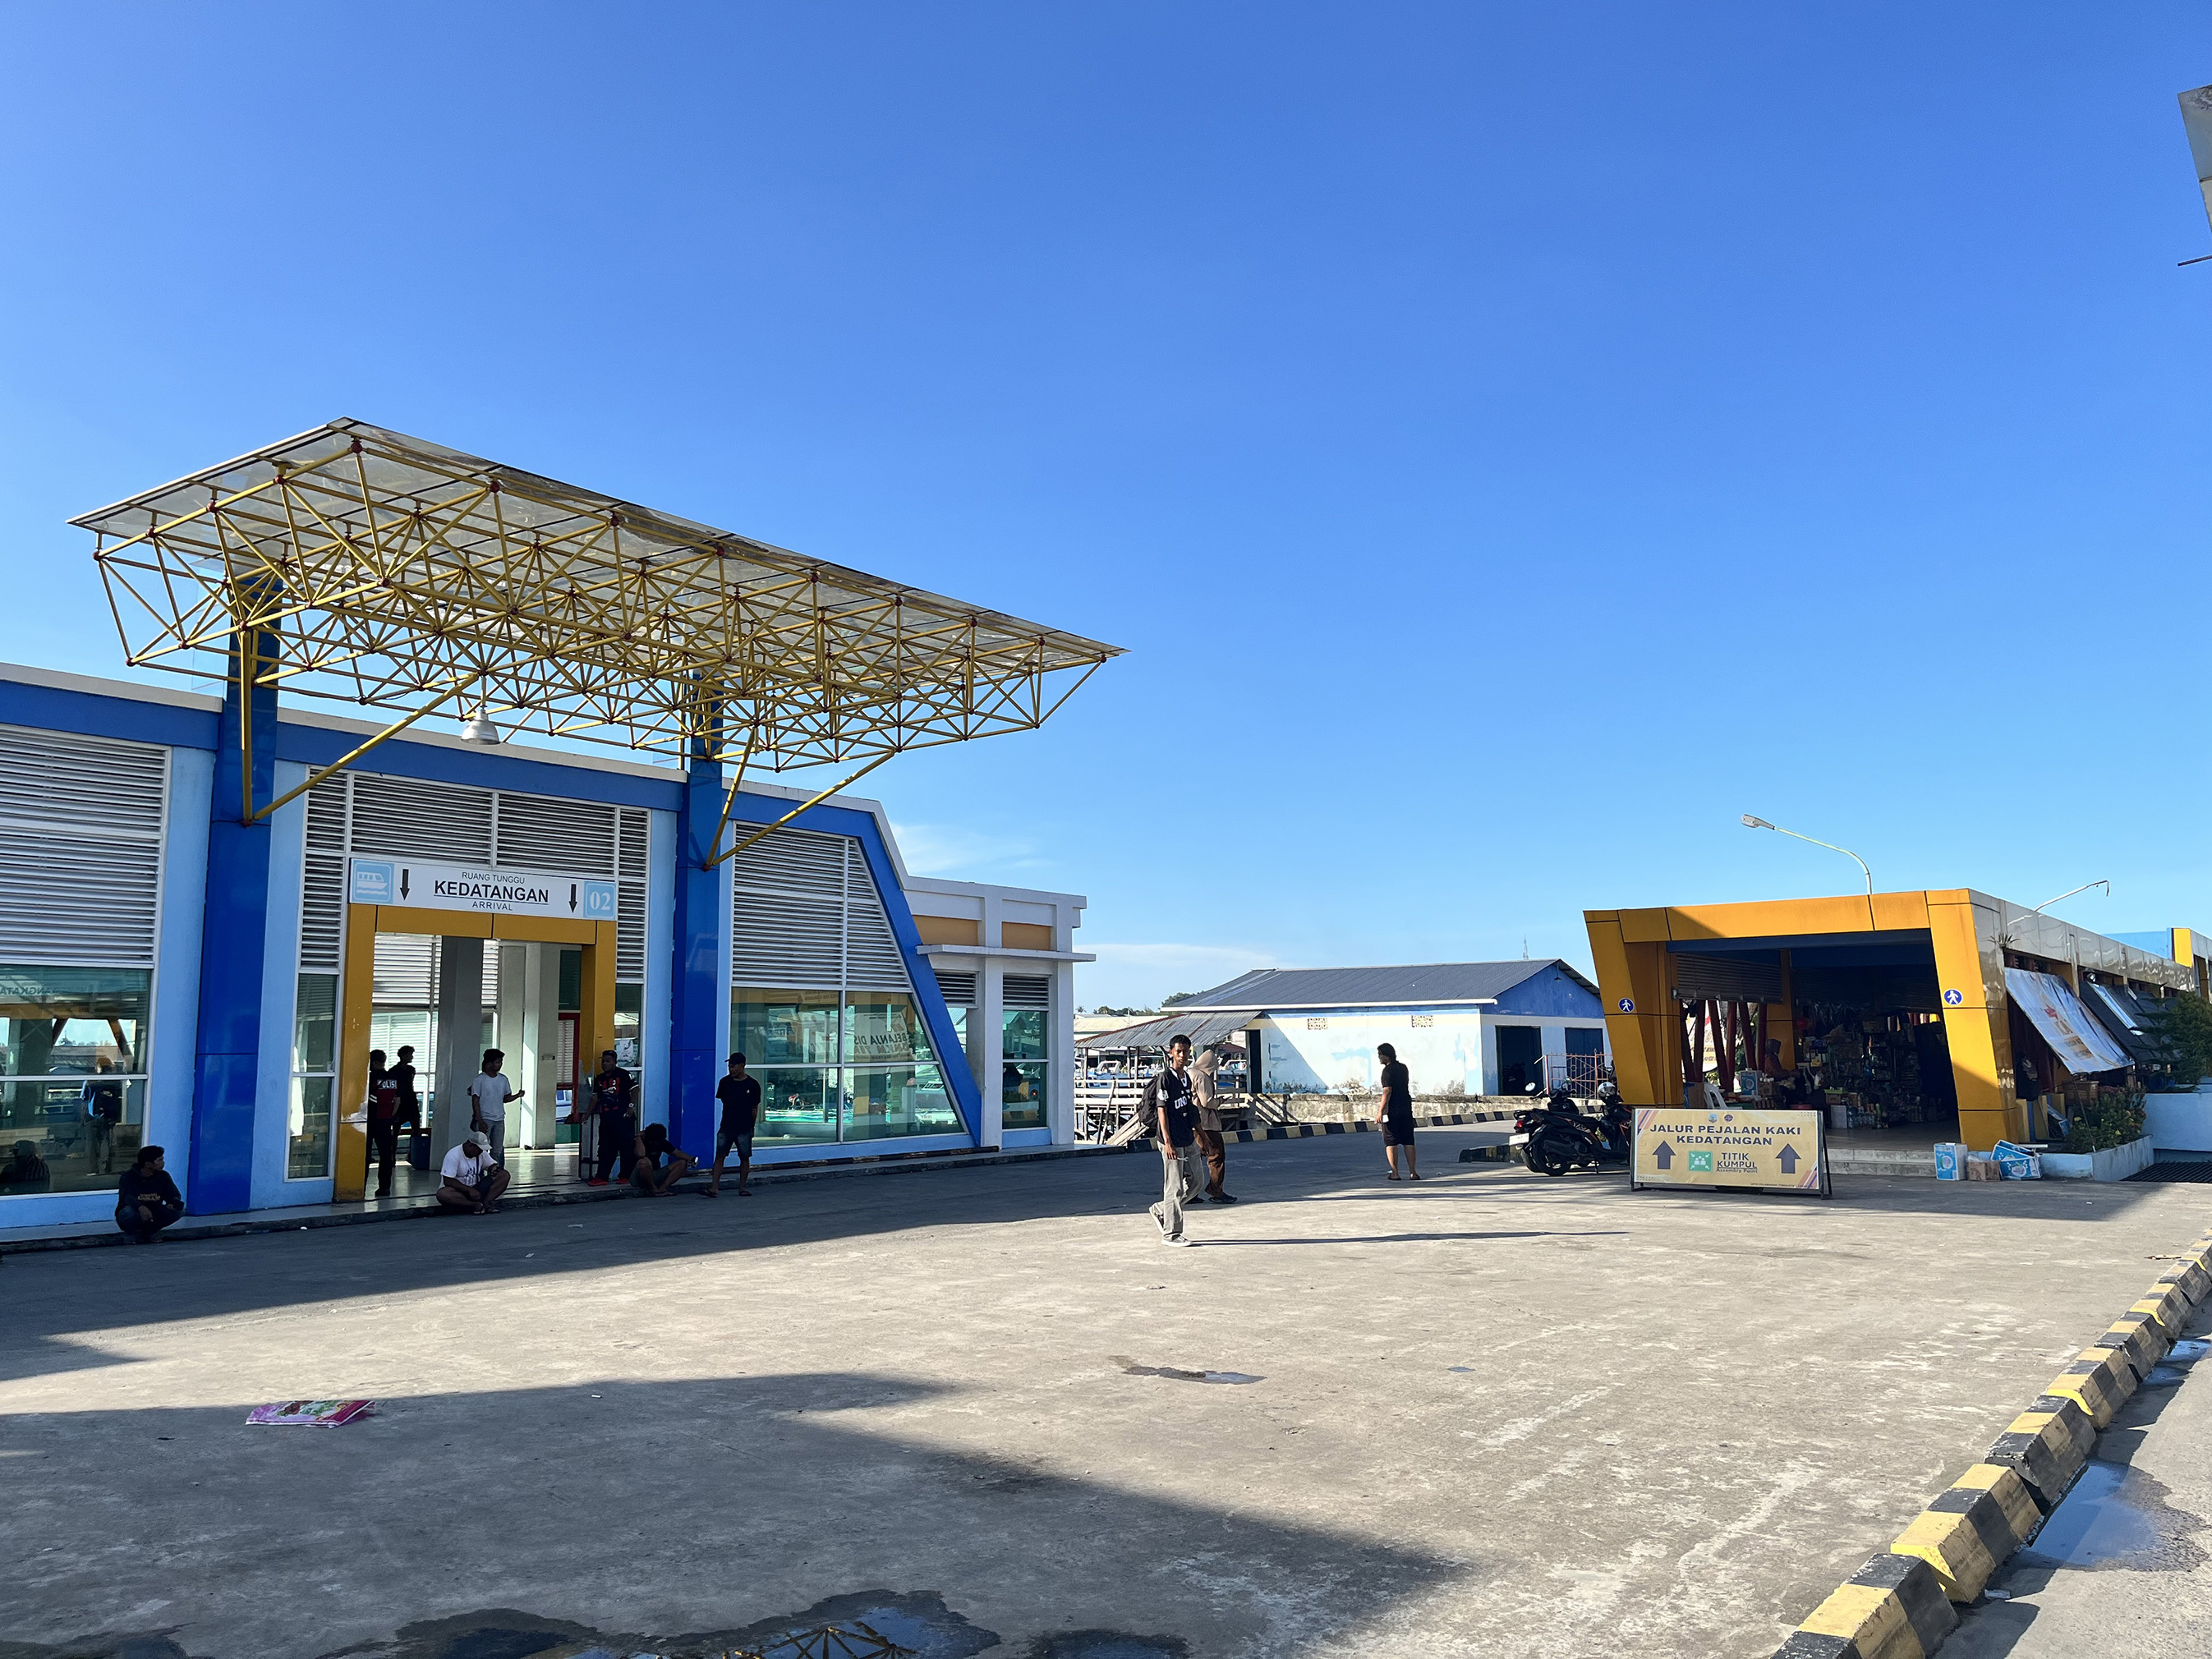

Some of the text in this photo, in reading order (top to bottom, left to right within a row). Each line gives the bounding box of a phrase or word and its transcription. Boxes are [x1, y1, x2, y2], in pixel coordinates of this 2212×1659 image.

[462, 871, 526, 885] RUANG TUNGGU
[435, 880, 549, 903] KEDATANGAN
[471, 901, 513, 911] ARRIVAL
[590, 891, 611, 911] 02
[1650, 1124, 1800, 1135] JALUR PEJALAN KAKI
[1676, 1135, 1773, 1146] KEDATANGAN
[1721, 1152, 1750, 1160] TITIK
[1717, 1160, 1757, 1169] KUMPUL
